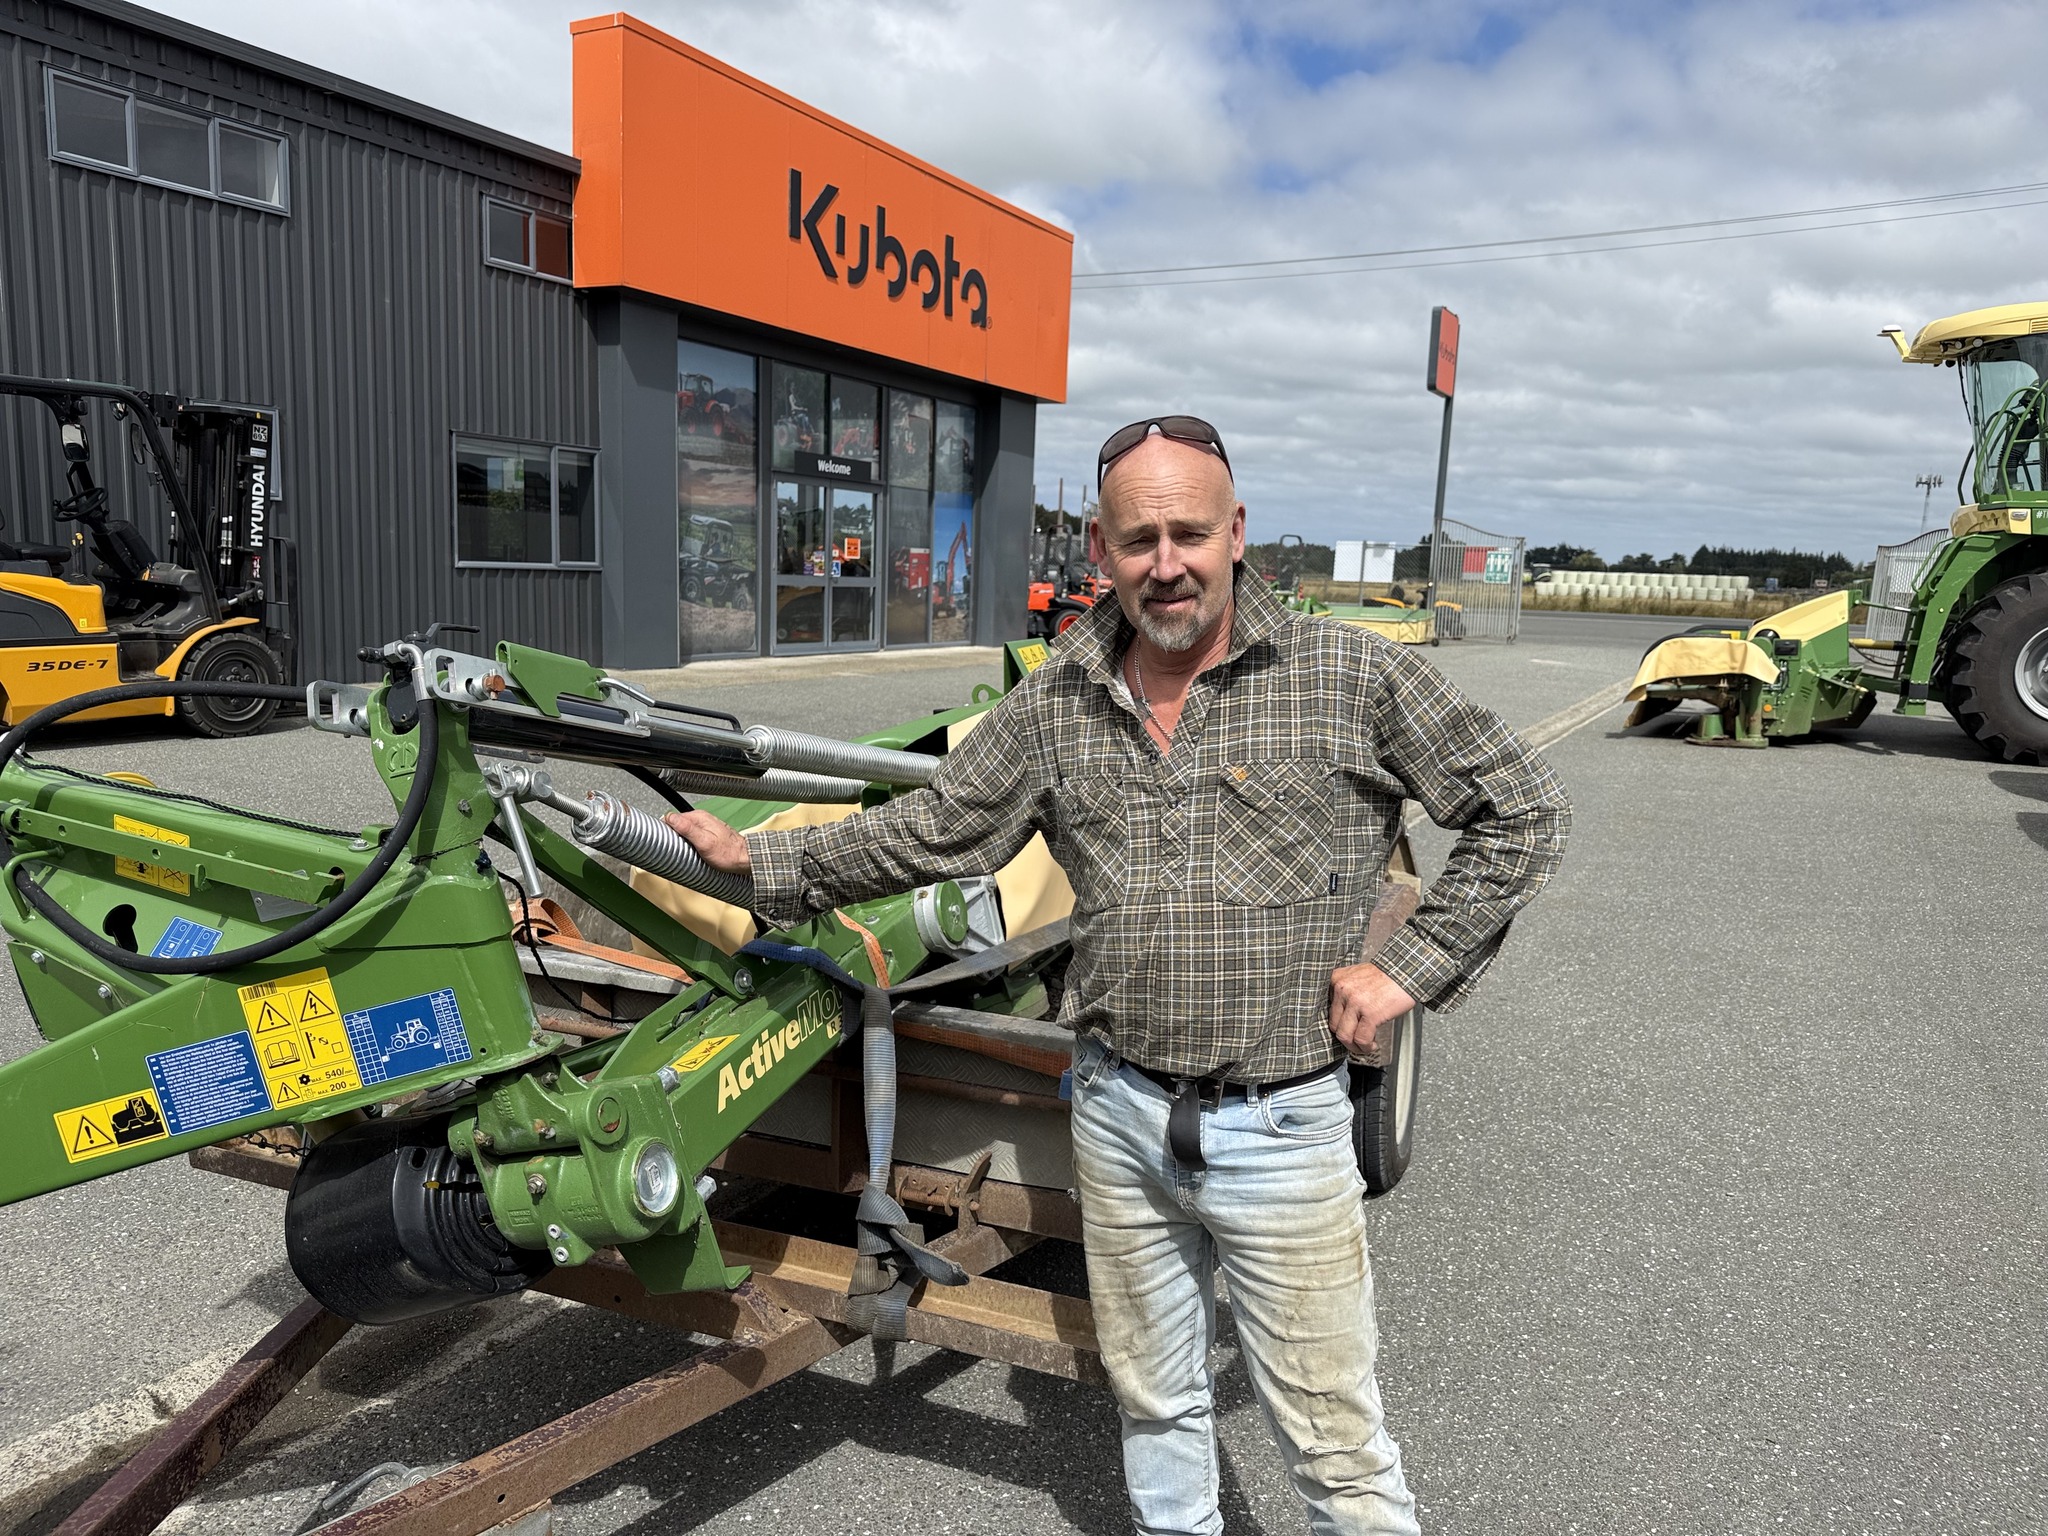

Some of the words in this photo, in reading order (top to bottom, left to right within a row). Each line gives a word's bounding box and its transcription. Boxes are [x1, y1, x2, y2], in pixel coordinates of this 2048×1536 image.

[789, 167, 988, 329] Kubota
[253, 426, 267, 434] NZ
[817, 459, 852, 476] Welcome
[251, 464, 265, 547] HYUNDAI
[26, 659, 109, 673] 35DE-7
[330, 1081, 347, 1092] 200
